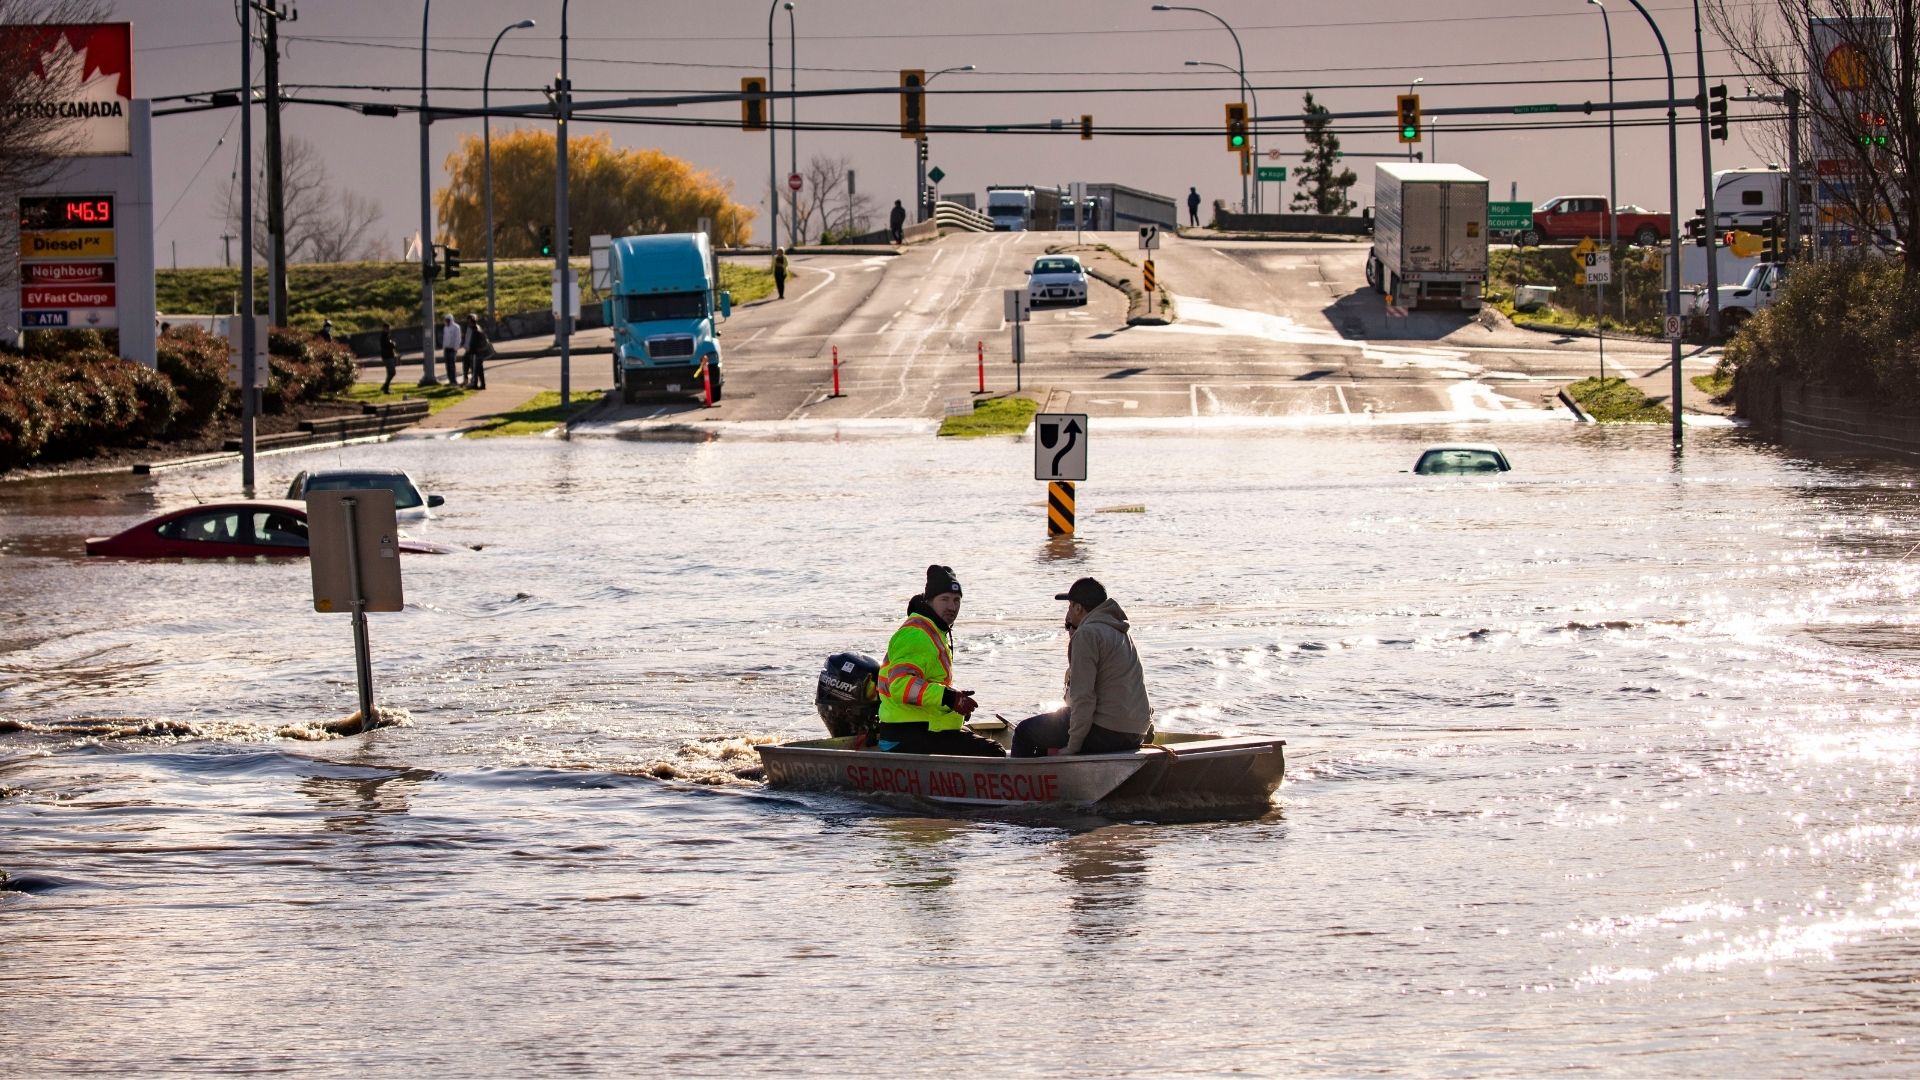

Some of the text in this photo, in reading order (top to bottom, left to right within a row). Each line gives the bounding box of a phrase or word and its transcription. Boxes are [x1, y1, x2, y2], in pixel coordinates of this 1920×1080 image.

[60, 101, 122, 118] CANADA
[66, 201, 109, 221] 146.9
[1491, 205, 1510, 214] Hope
[1488, 218, 1518, 227] ncouver
[33, 237, 100, 250] Diesel PX
[32, 265, 103, 279] Neighbours
[1588, 272, 1609, 282] ENDS
[28, 292, 108, 304] EV Fast Charge
[39, 313, 63, 324] ATM
[847, 764, 922, 796] SEARCH
[928, 770, 966, 797] AND
[973, 773, 1057, 802] RESCUE
